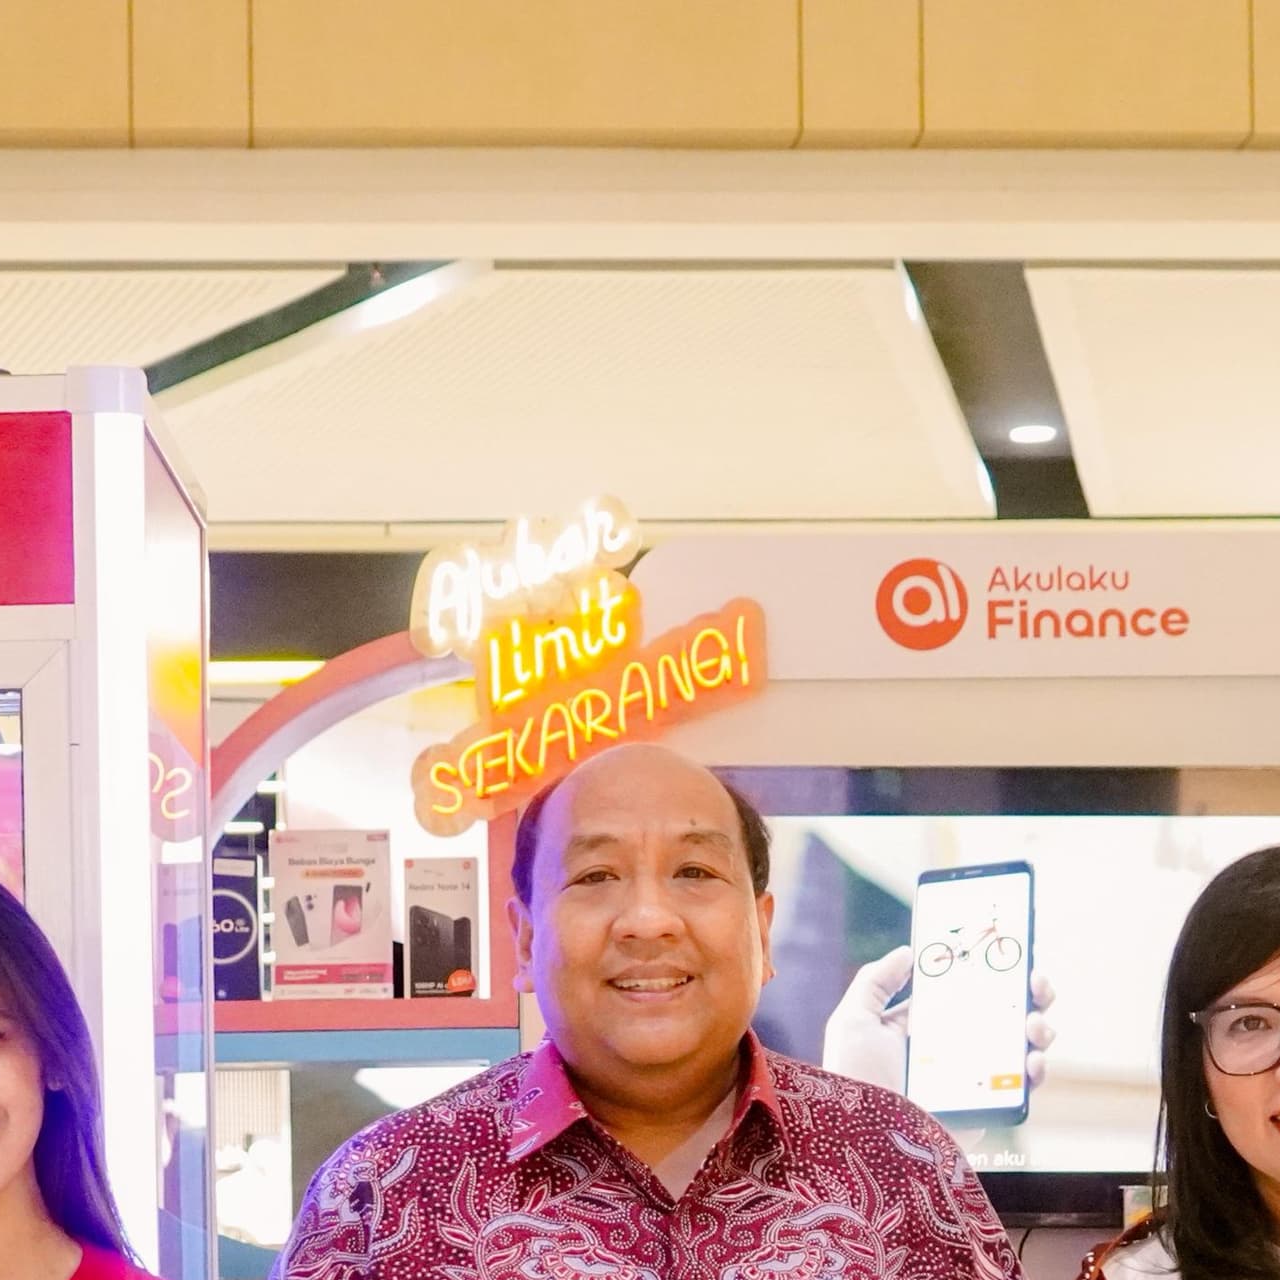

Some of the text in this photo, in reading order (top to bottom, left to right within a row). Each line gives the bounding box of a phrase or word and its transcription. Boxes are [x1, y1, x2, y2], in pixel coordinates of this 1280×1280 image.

[987, 564, 1131, 593] Akulaku
[987, 600, 1190, 640] Finance
[490, 576, 626, 711] Limit
